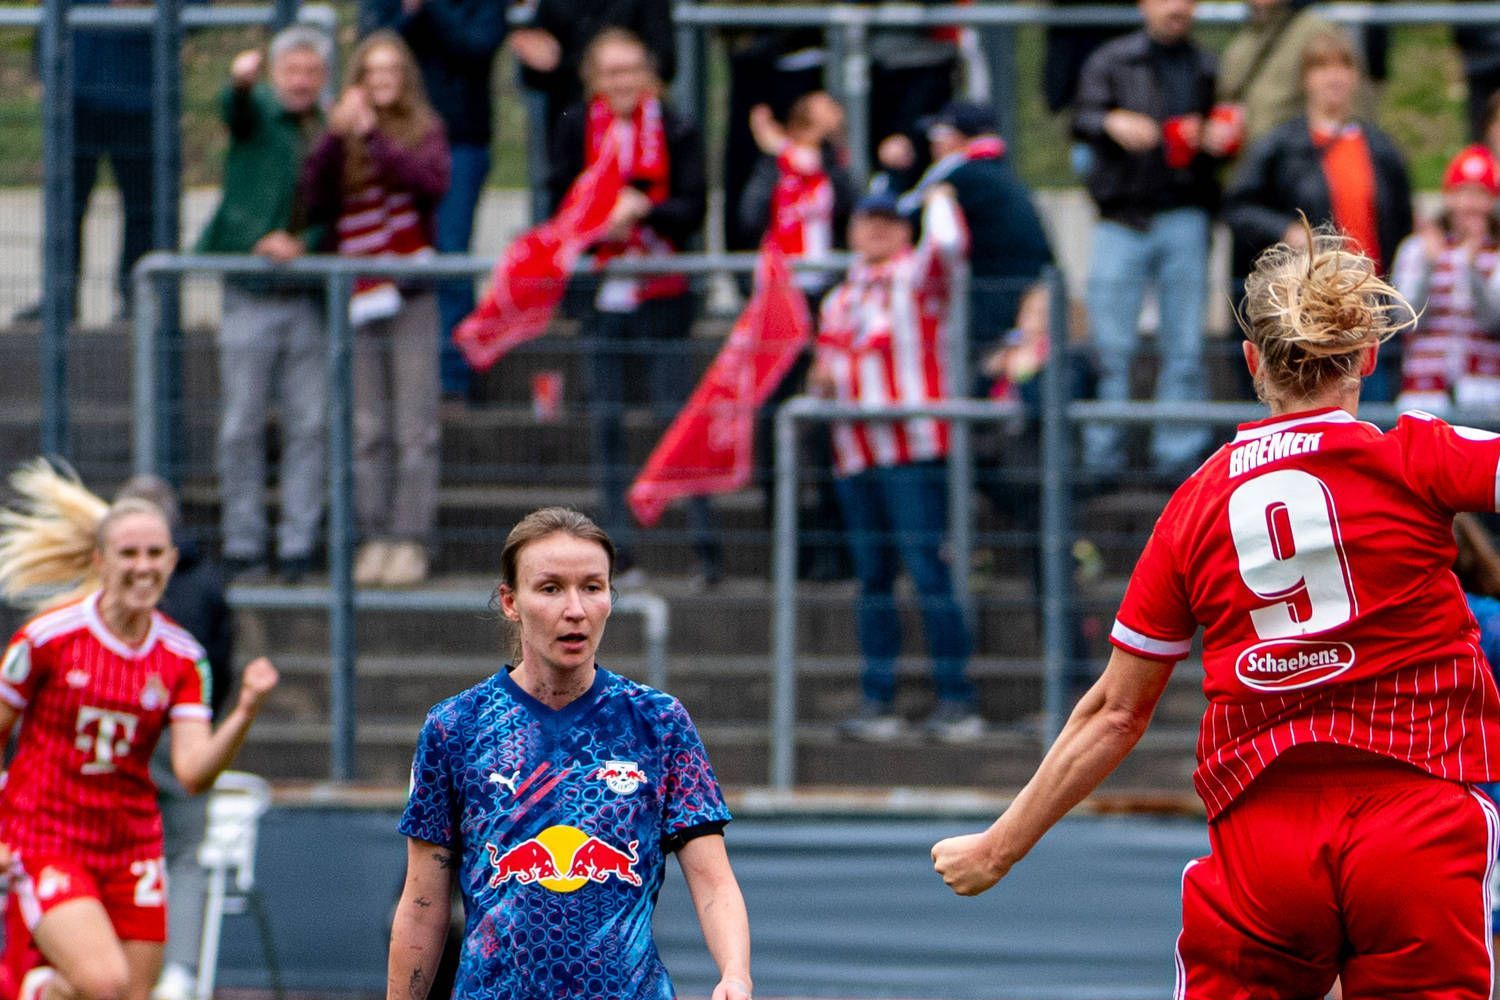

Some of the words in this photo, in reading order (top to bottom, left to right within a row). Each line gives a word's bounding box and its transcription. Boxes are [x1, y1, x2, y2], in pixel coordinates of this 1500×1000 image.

[1229, 469, 1358, 640] 9
[1247, 648, 1338, 673] Schaebens
[75, 706, 138, 775] T
